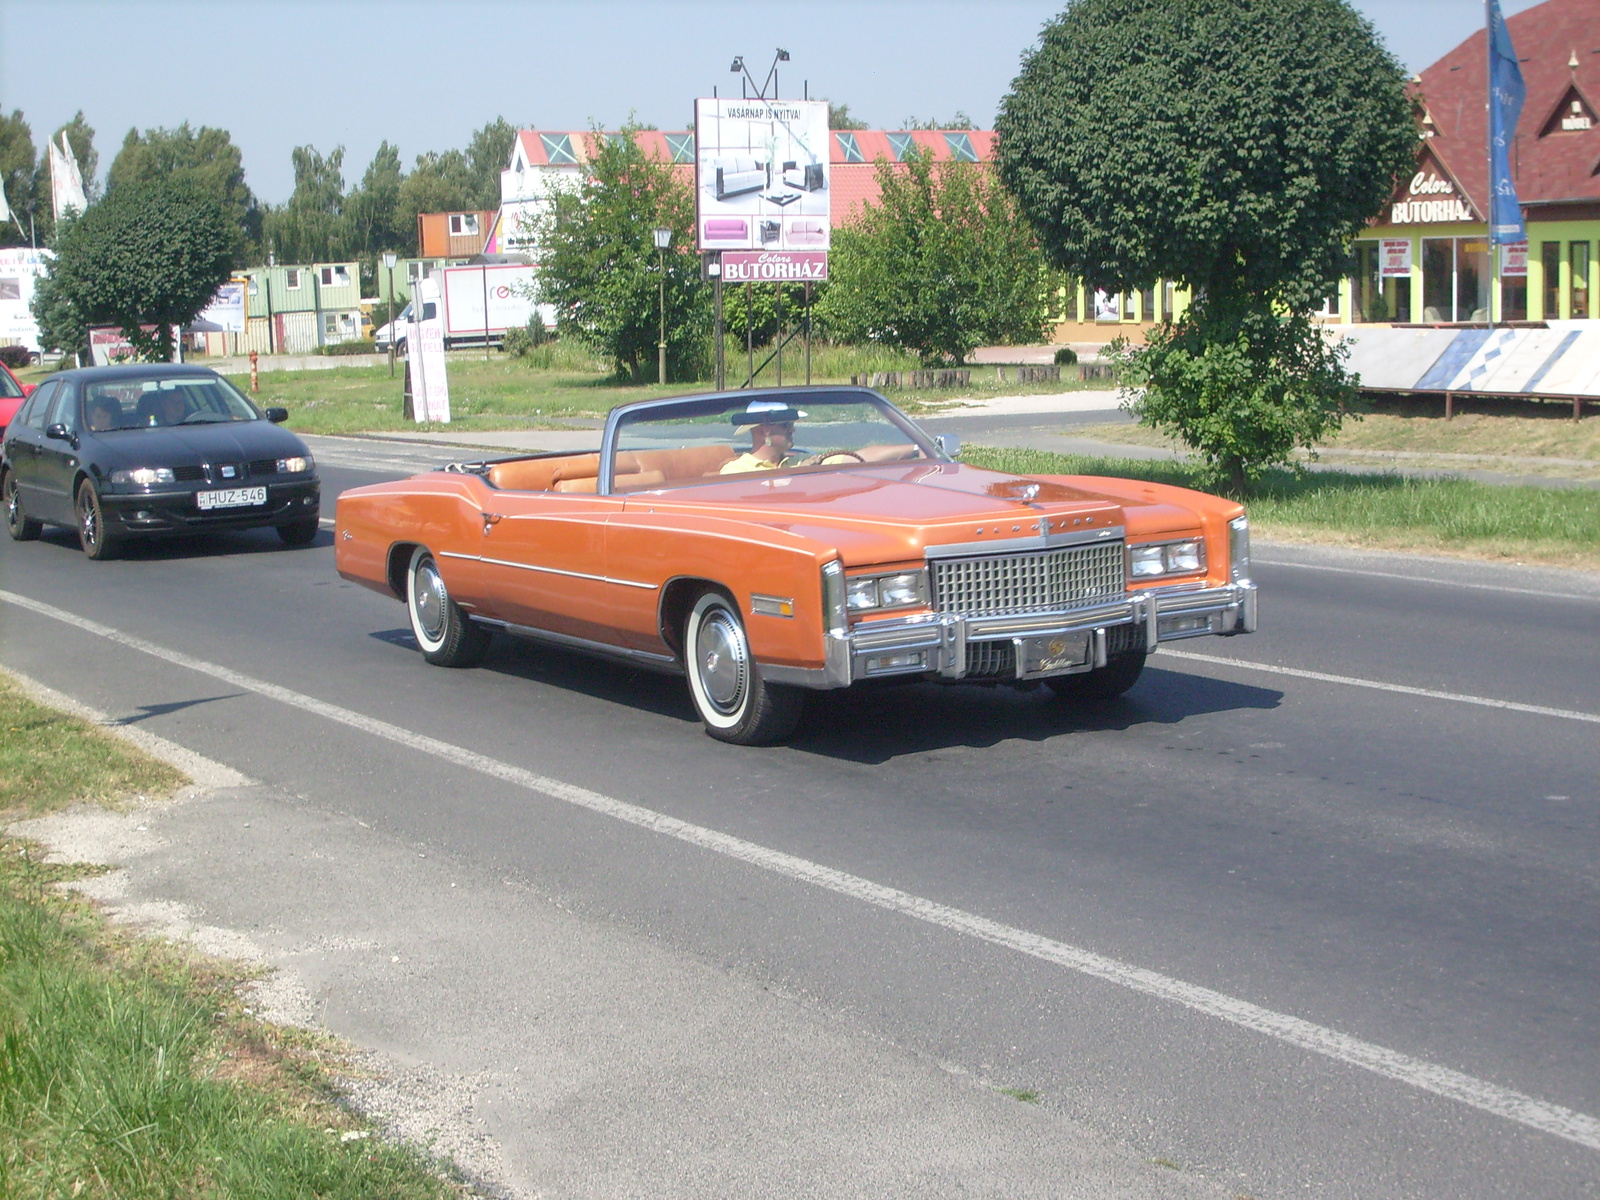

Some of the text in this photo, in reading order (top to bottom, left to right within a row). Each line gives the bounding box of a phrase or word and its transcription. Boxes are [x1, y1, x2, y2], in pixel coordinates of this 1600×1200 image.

[727, 105, 801, 121] VASÁRNAP IS NYITVA!
[1409, 171, 1454, 196] Colors
[1391, 194, 1474, 225] BÚTORHÁZ
[758, 252, 792, 263] Colors
[725, 259, 824, 279] BÚTORHÁZ
[208, 488, 265, 504] HUZ-546
